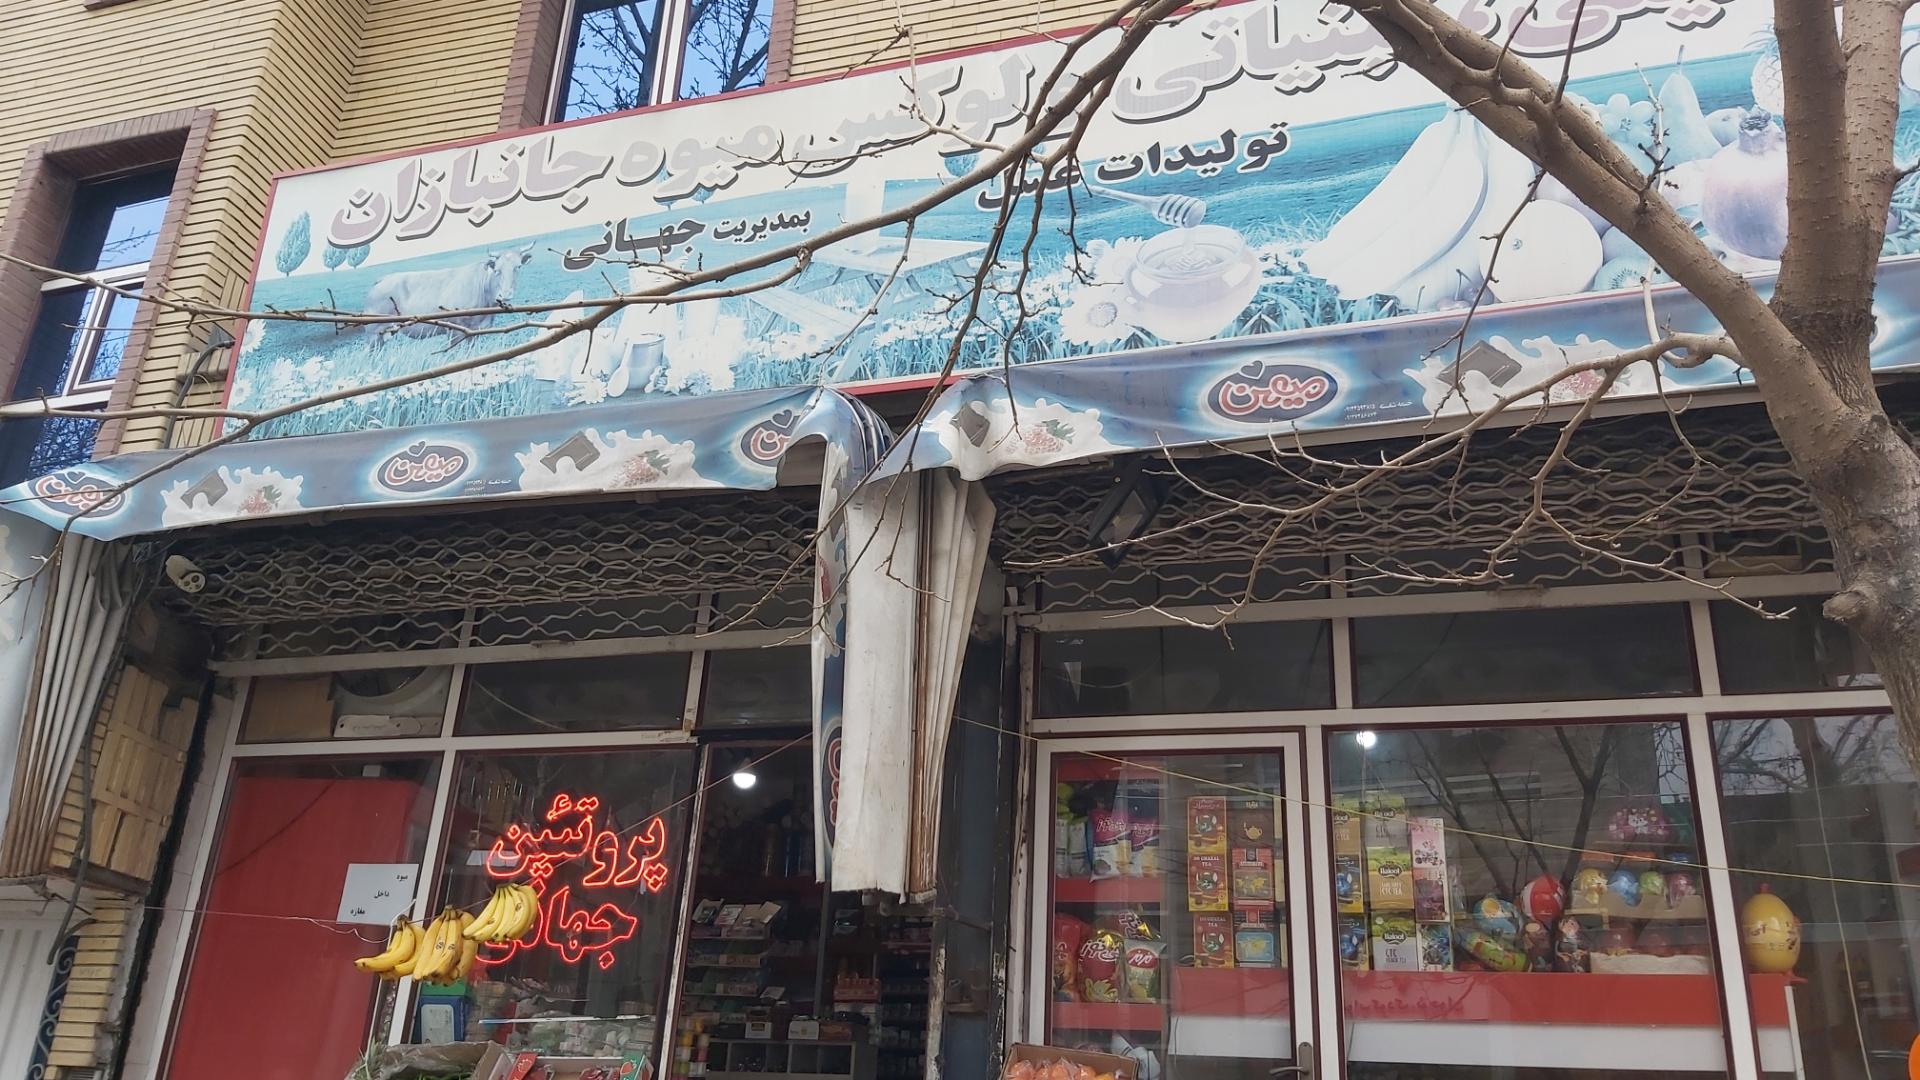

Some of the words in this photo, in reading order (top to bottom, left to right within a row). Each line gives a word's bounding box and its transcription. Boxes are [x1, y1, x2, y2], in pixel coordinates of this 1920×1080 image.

[616, 124, 785, 203] میوه
[1098, 121, 1289, 182] تولیدات
[327, 134, 614, 249] جانبازان
[563, 216, 705, 270] جهانی
[713, 208, 812, 243] بمدیریت
[1219, 373, 1330, 416] میهن
[384, 453, 464, 486] میهن
[487, 793, 668, 892] پروتئین
